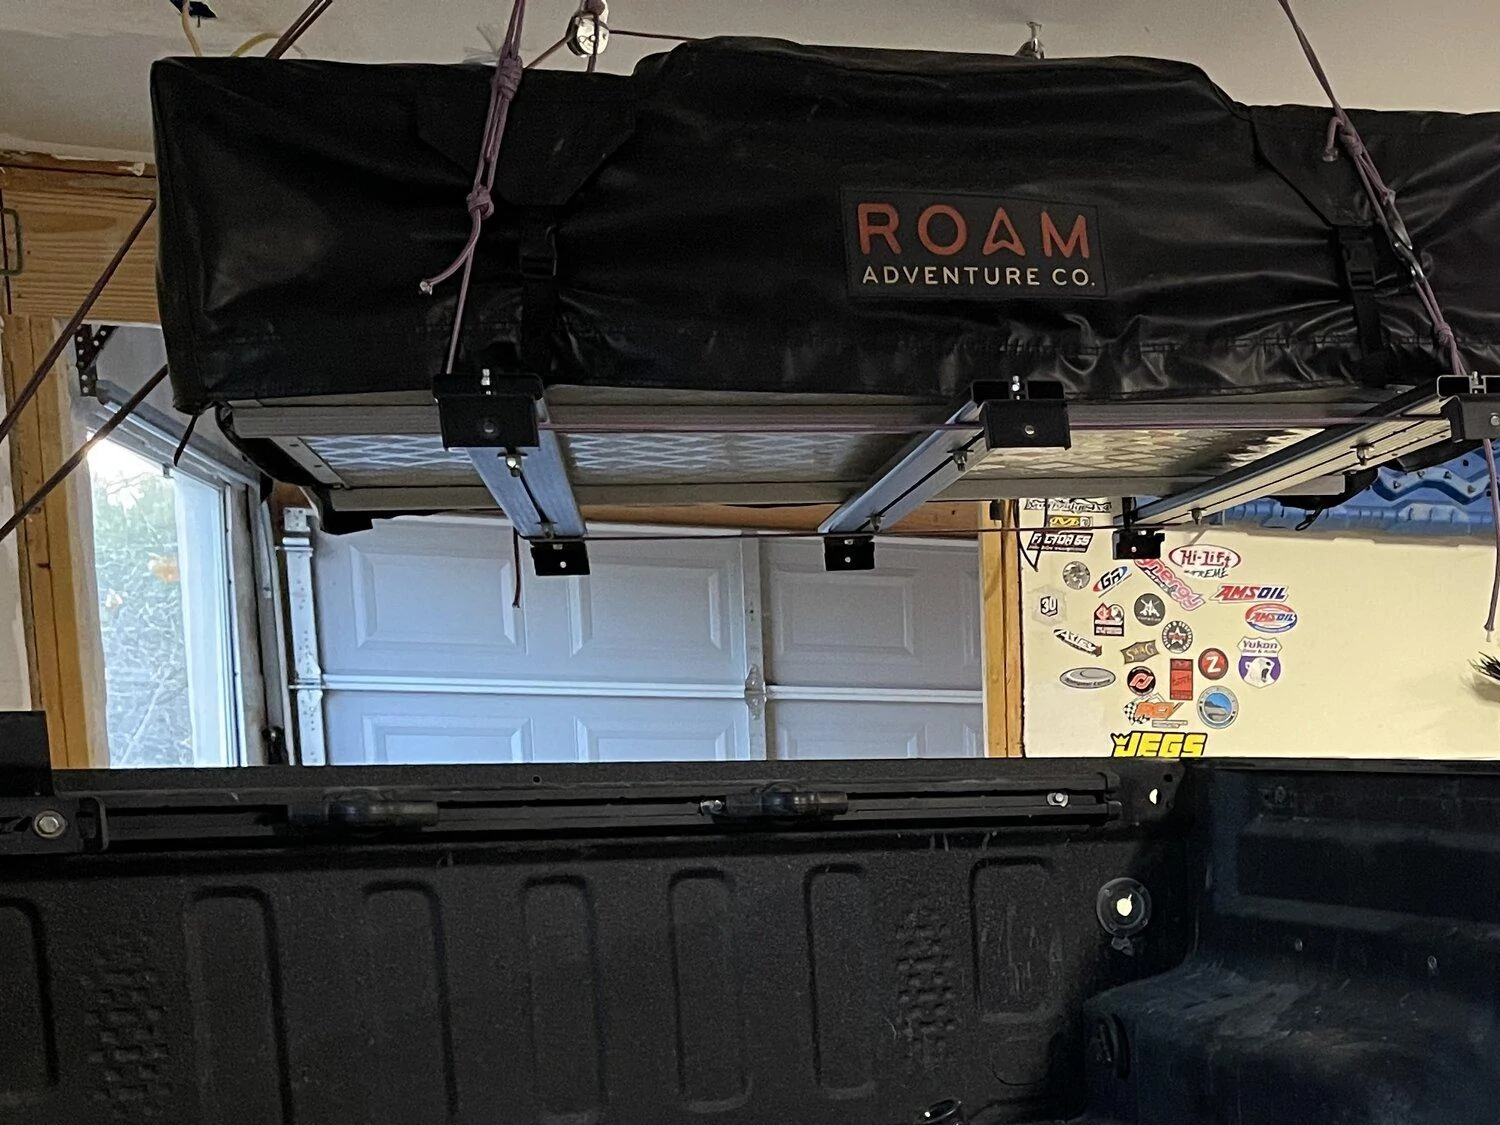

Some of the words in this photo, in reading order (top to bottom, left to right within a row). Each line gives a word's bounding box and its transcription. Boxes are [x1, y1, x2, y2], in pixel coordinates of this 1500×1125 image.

[857, 202, 1090, 260] ROAM
[862, 265, 1040, 286] ADVENTURE
[1051, 267, 1096, 287] CO.
[1180, 550, 1232, 568] Hi-Lift
[1214, 585, 1287, 601] AMSOIL
[1249, 612, 1294, 623] AMSOIL
[1242, 640, 1278, 650] Yukon
[1206, 655, 1222, 673] Z
[1112, 732, 1207, 758] JEGS
